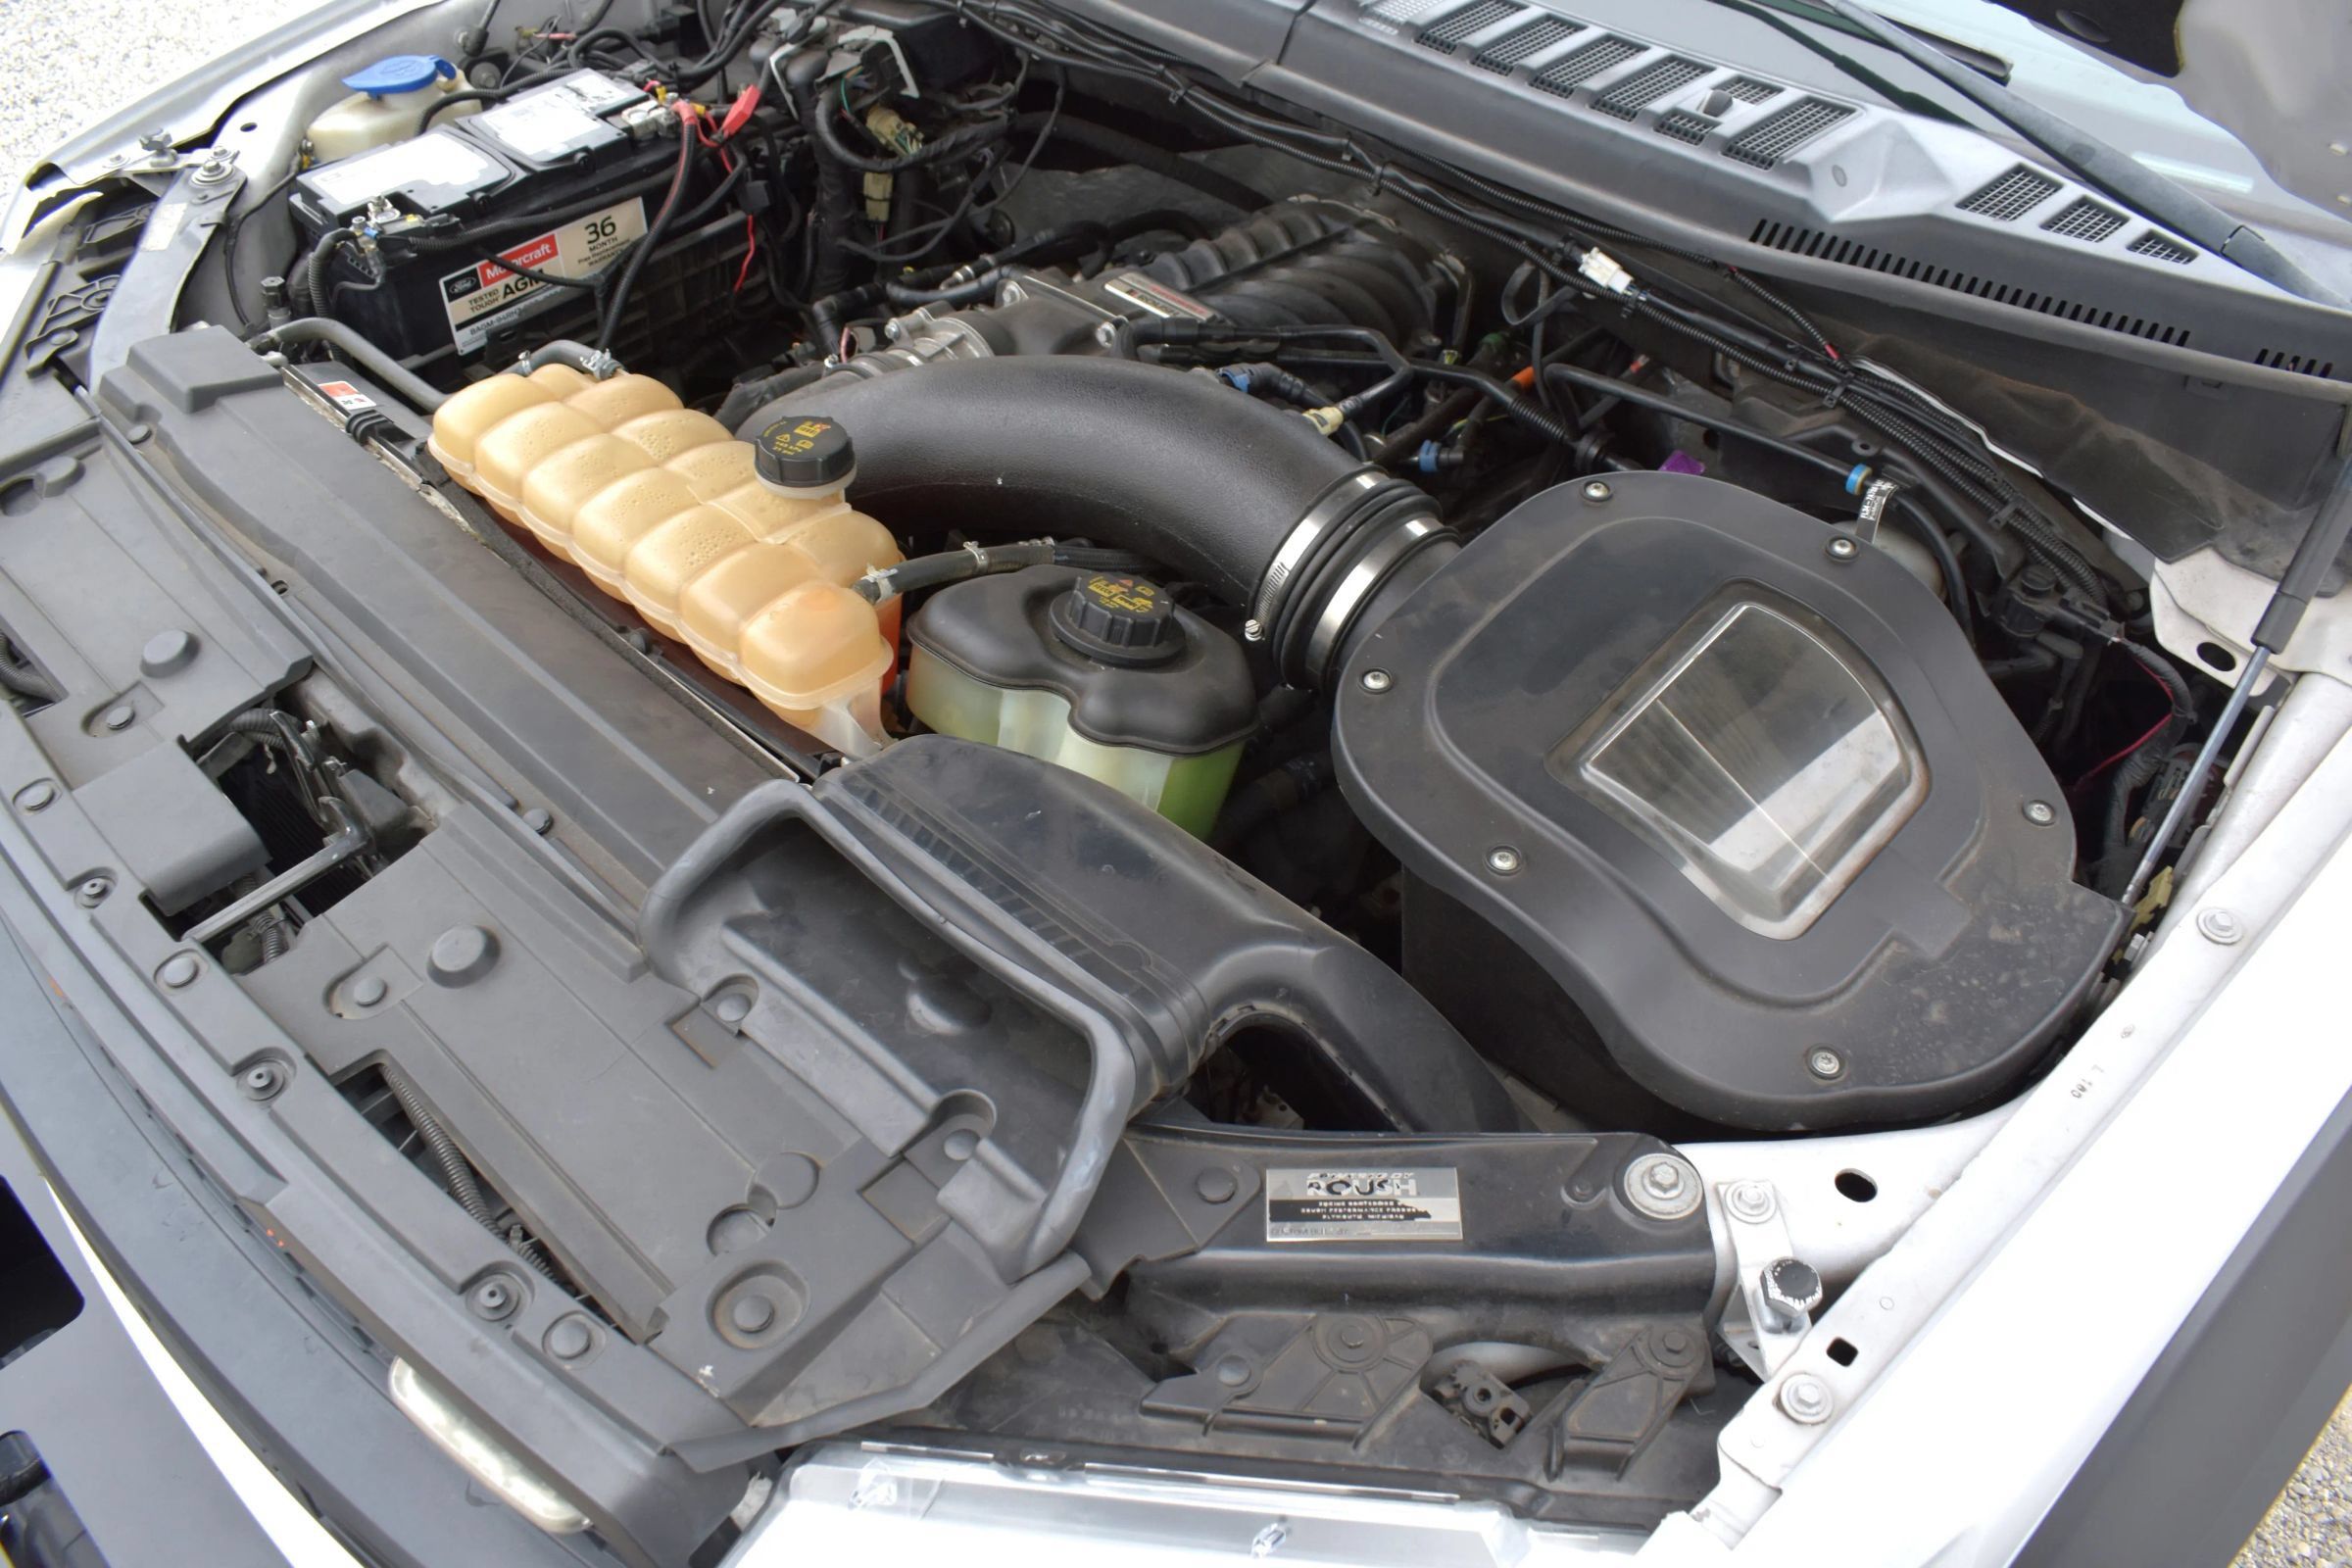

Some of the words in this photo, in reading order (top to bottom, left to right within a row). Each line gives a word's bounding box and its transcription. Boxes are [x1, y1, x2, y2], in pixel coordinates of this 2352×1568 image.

[584, 215, 616, 245] 36
[589, 236, 618, 252] MONTH
[468, 288, 499, 306] TESTED
[1306, 1178, 1417, 1197] ROUSH
